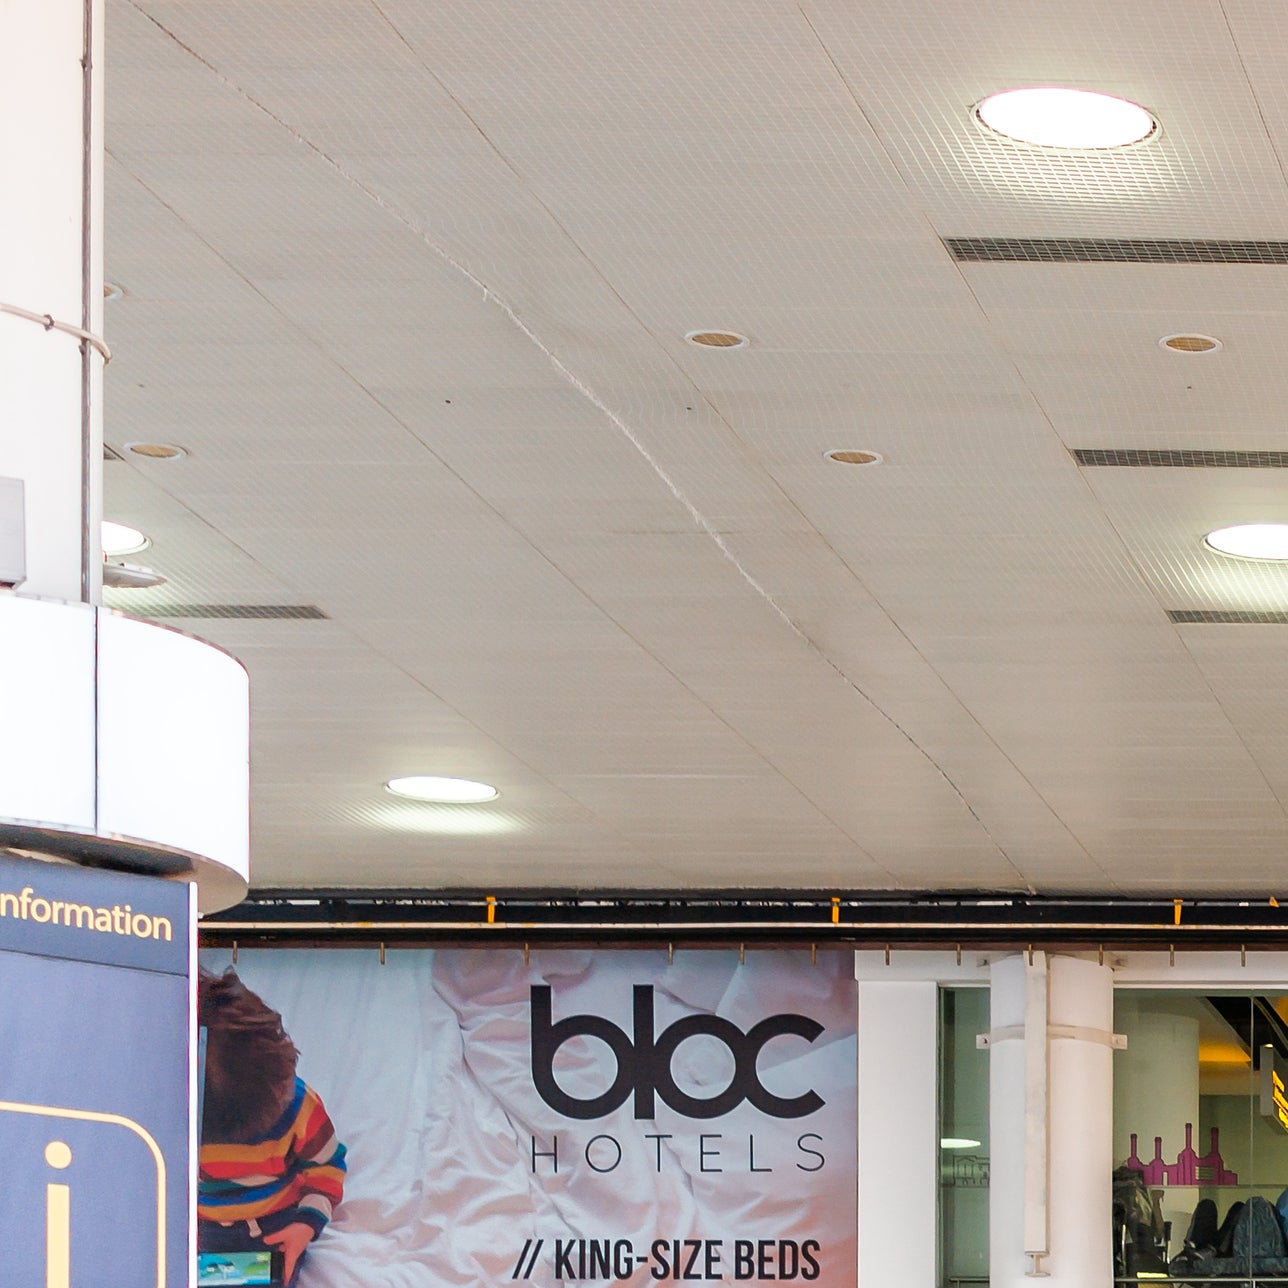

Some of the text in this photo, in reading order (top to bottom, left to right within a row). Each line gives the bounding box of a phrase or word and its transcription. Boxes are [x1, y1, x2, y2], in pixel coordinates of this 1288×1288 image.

[530, 984, 826, 1120] bloc
[532, 1133, 825, 1173] HOTELS
[555, 1239, 722, 1281] KING-SIZE
[734, 1239, 821, 1281] BEDS
